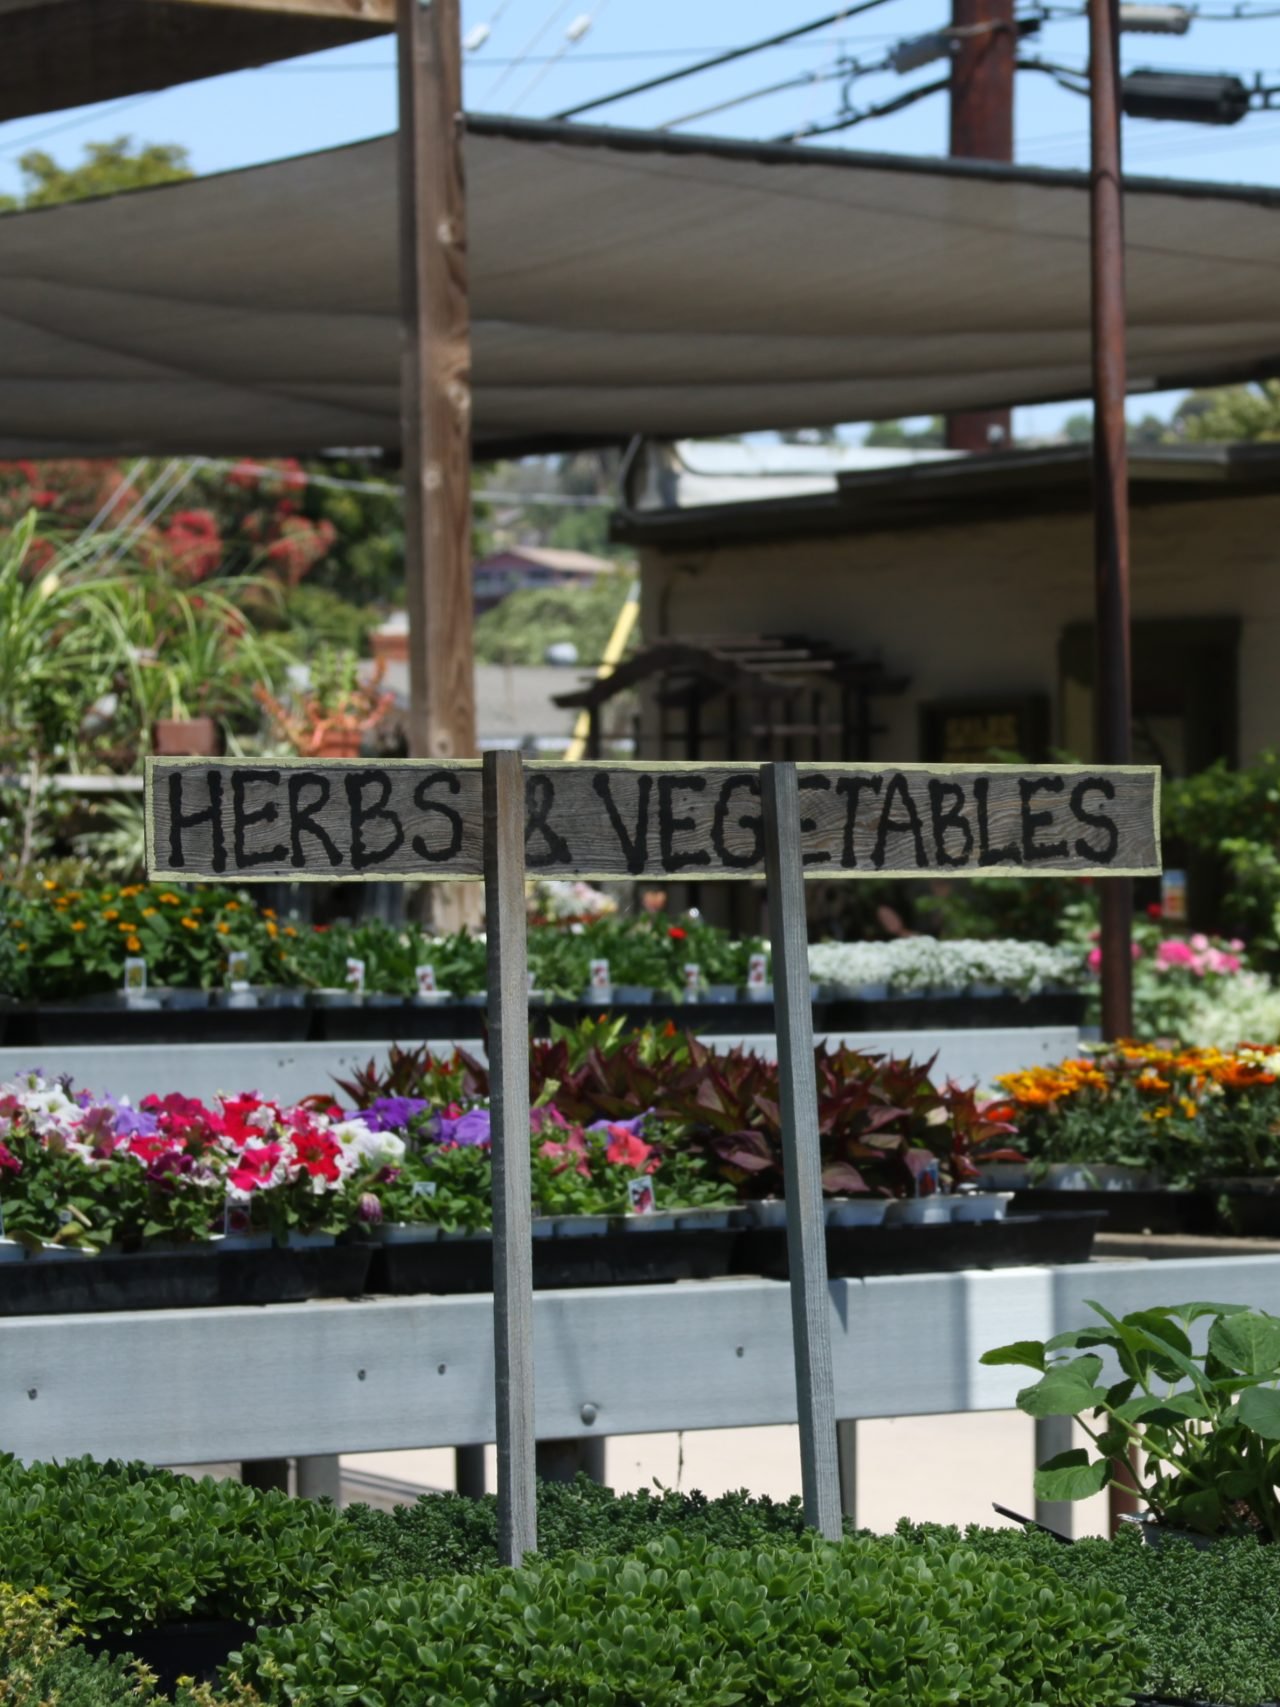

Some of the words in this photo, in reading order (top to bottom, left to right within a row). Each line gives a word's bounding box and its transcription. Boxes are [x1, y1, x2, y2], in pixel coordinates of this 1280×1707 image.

[168, 769, 464, 872] HERBS
[525, 773, 572, 867] &
[592, 772, 1119, 875] VEGETABLES
